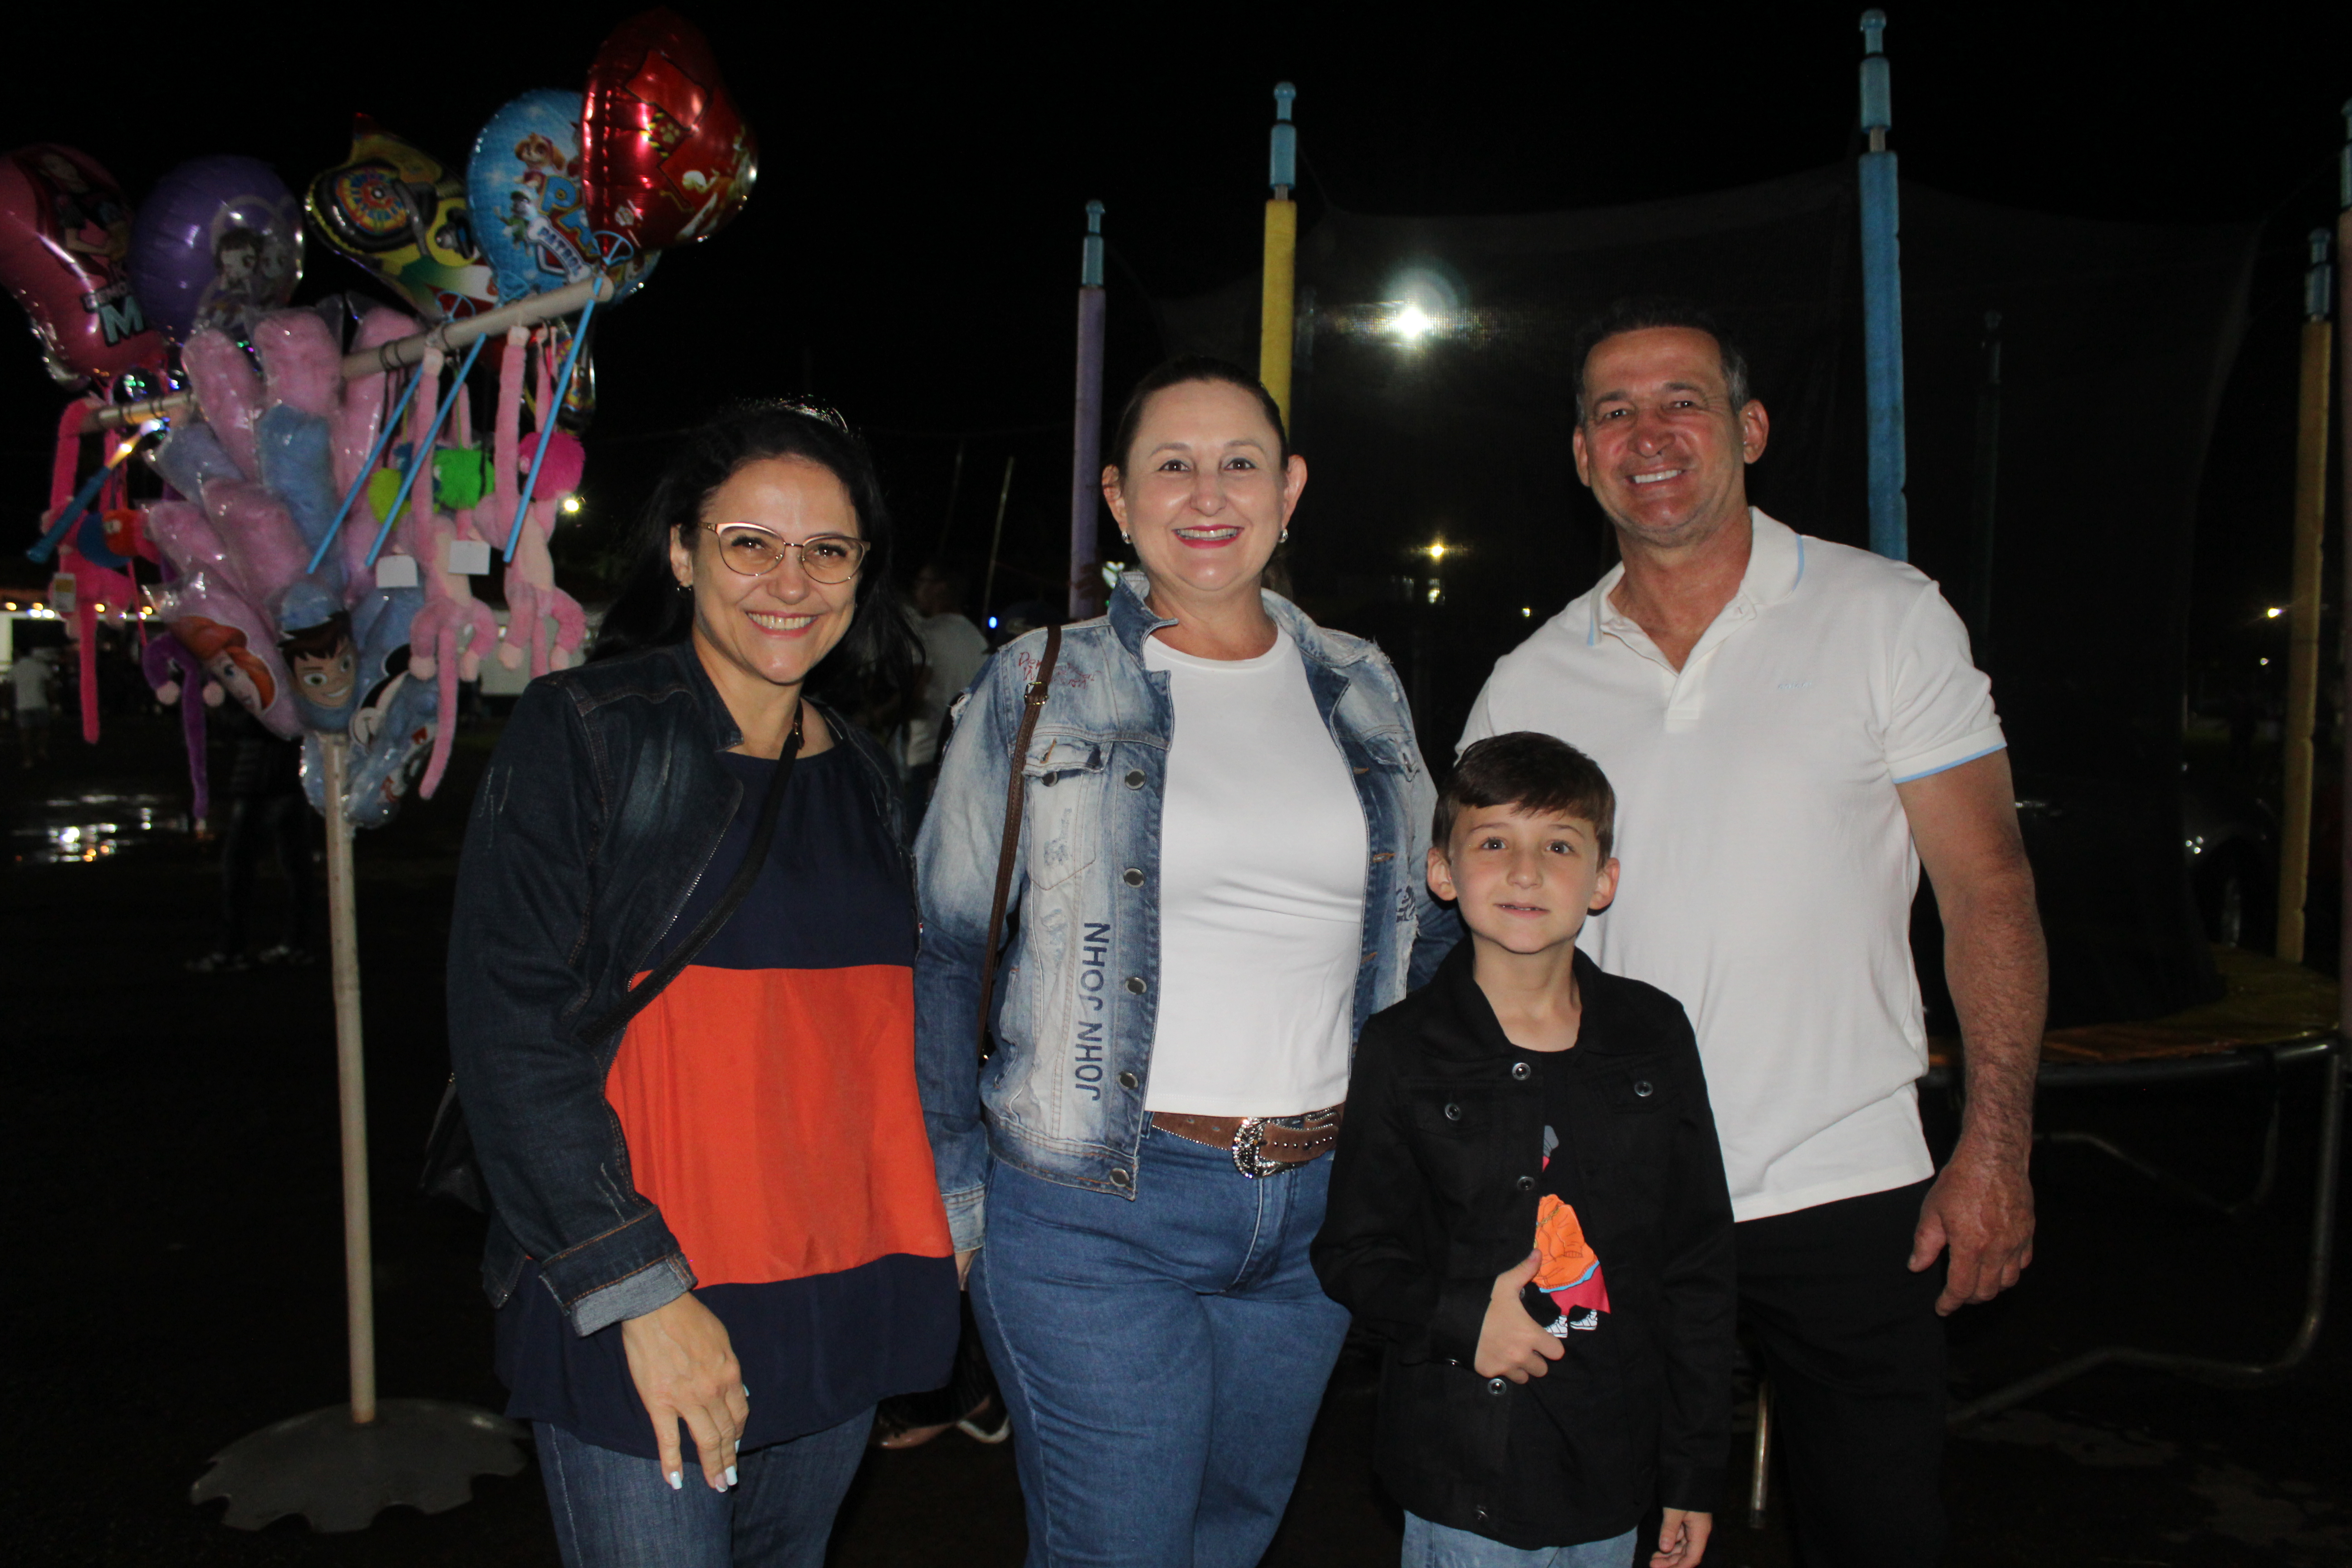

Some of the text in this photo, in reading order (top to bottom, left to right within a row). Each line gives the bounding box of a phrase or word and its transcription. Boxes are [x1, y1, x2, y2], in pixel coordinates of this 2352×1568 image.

[537, 227, 581, 276] PATROL
[539, 175, 601, 258] PA
[1075, 923, 1110, 1101] JOHN JOHN
